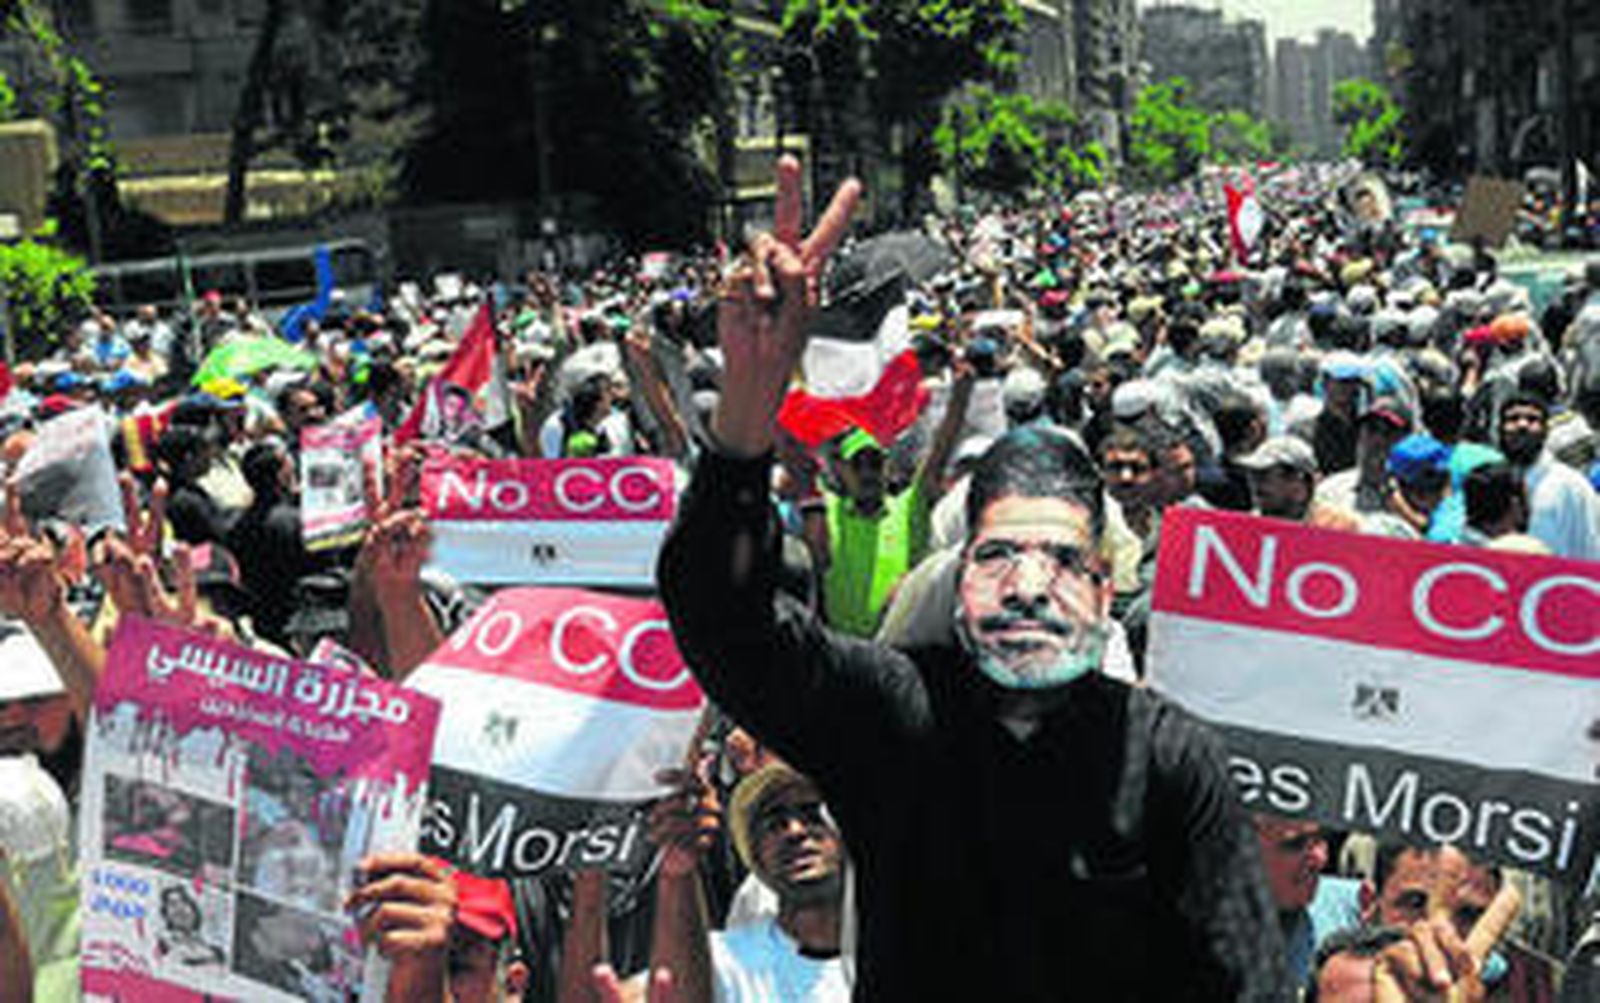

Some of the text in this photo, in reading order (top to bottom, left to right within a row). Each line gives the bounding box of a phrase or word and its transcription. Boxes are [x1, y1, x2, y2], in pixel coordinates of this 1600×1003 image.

[437, 467, 662, 512] No CC
[1188, 524, 1600, 656] No CC
[551, 606, 691, 690] CC
[1227, 756, 1580, 870] es Morsi
